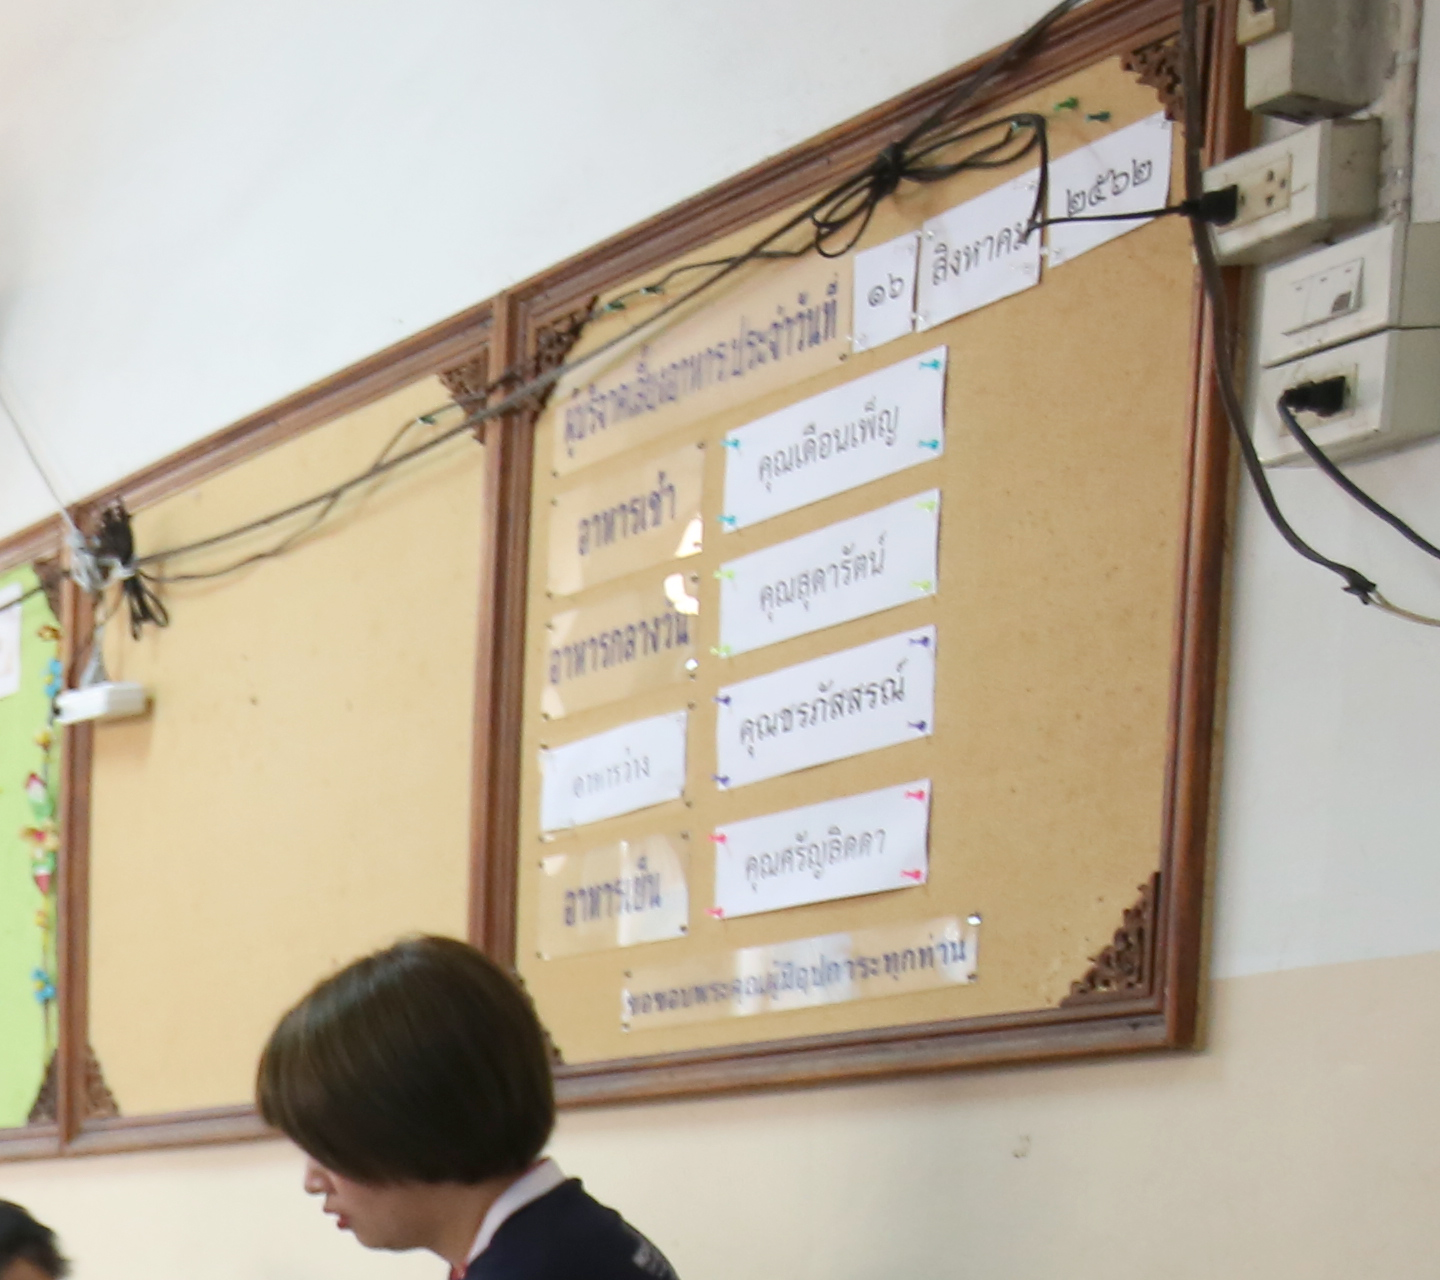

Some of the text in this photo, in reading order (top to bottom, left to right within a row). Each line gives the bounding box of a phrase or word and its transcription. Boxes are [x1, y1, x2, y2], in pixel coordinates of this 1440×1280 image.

[866, 273, 905, 308] ๑๖
[932, 226, 1030, 286] สิงหาคม
[1065, 157, 1153, 217] ๒๕๖๒
[577, 395, 900, 556] อาหารเช้า คุณเดือนเพ็ญ
[760, 534, 887, 625] คุณสุดารัตน์
